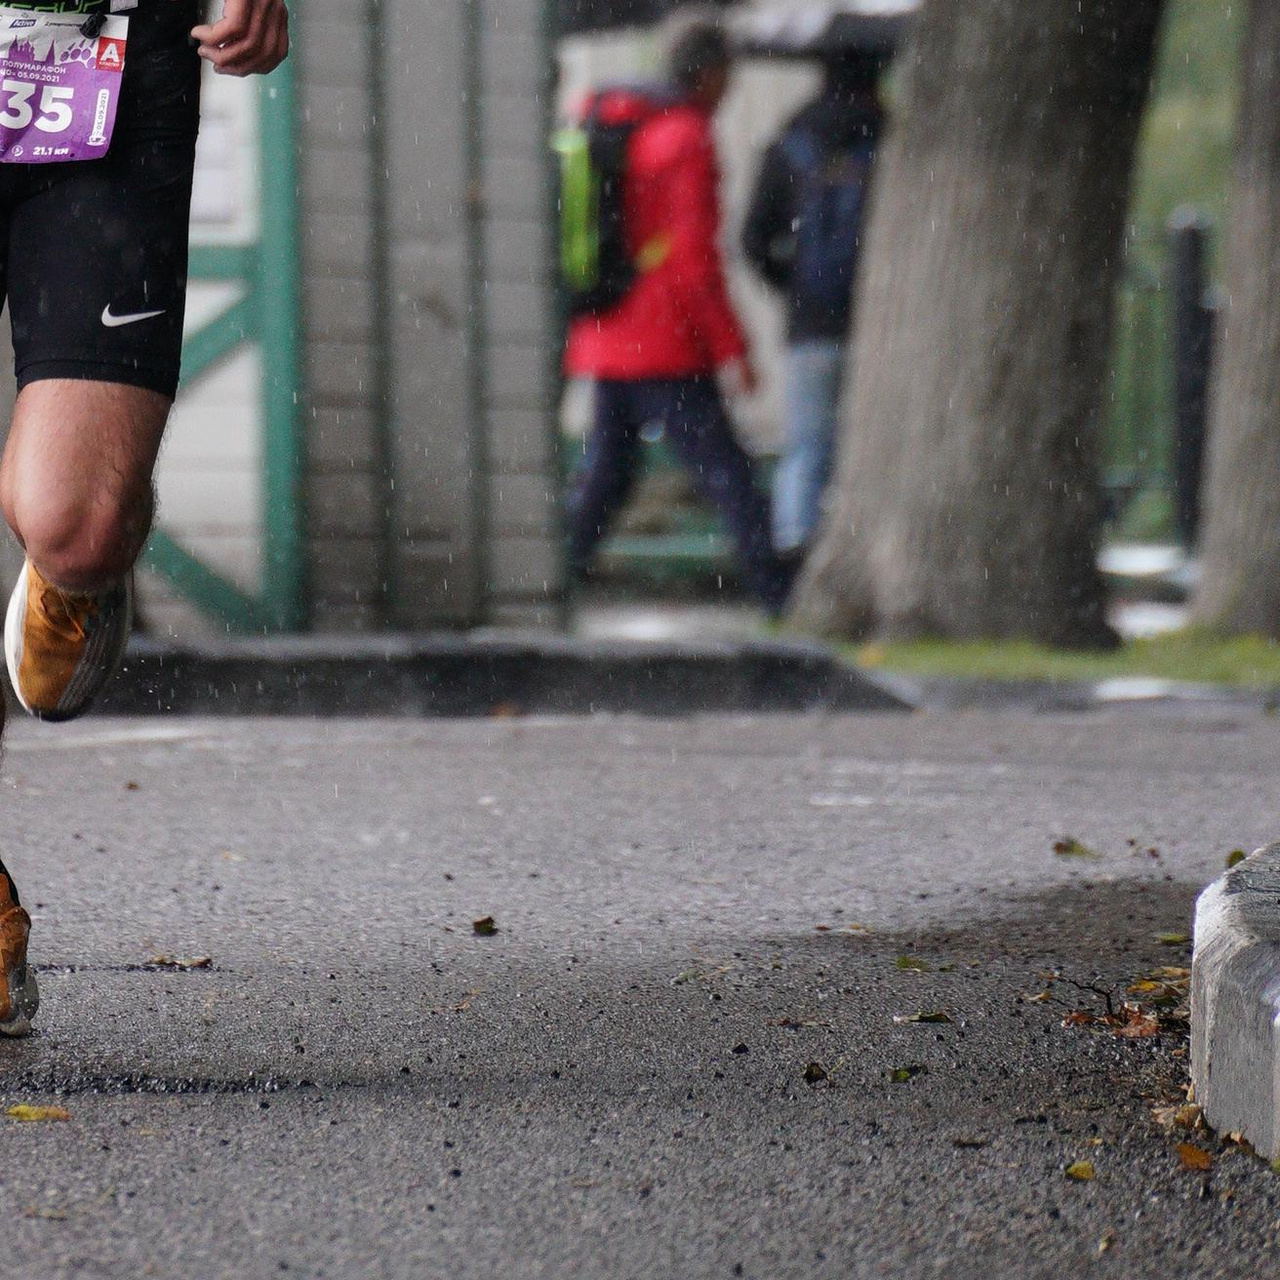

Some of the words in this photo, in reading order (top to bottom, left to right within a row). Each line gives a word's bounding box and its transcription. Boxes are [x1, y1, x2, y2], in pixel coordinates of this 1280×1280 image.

[2, 60, 67, 74] ПОЛУМАРАФОН
[17, 71, 60, 83] 05.09.2021
[32, 147, 53, 156] 21.1
